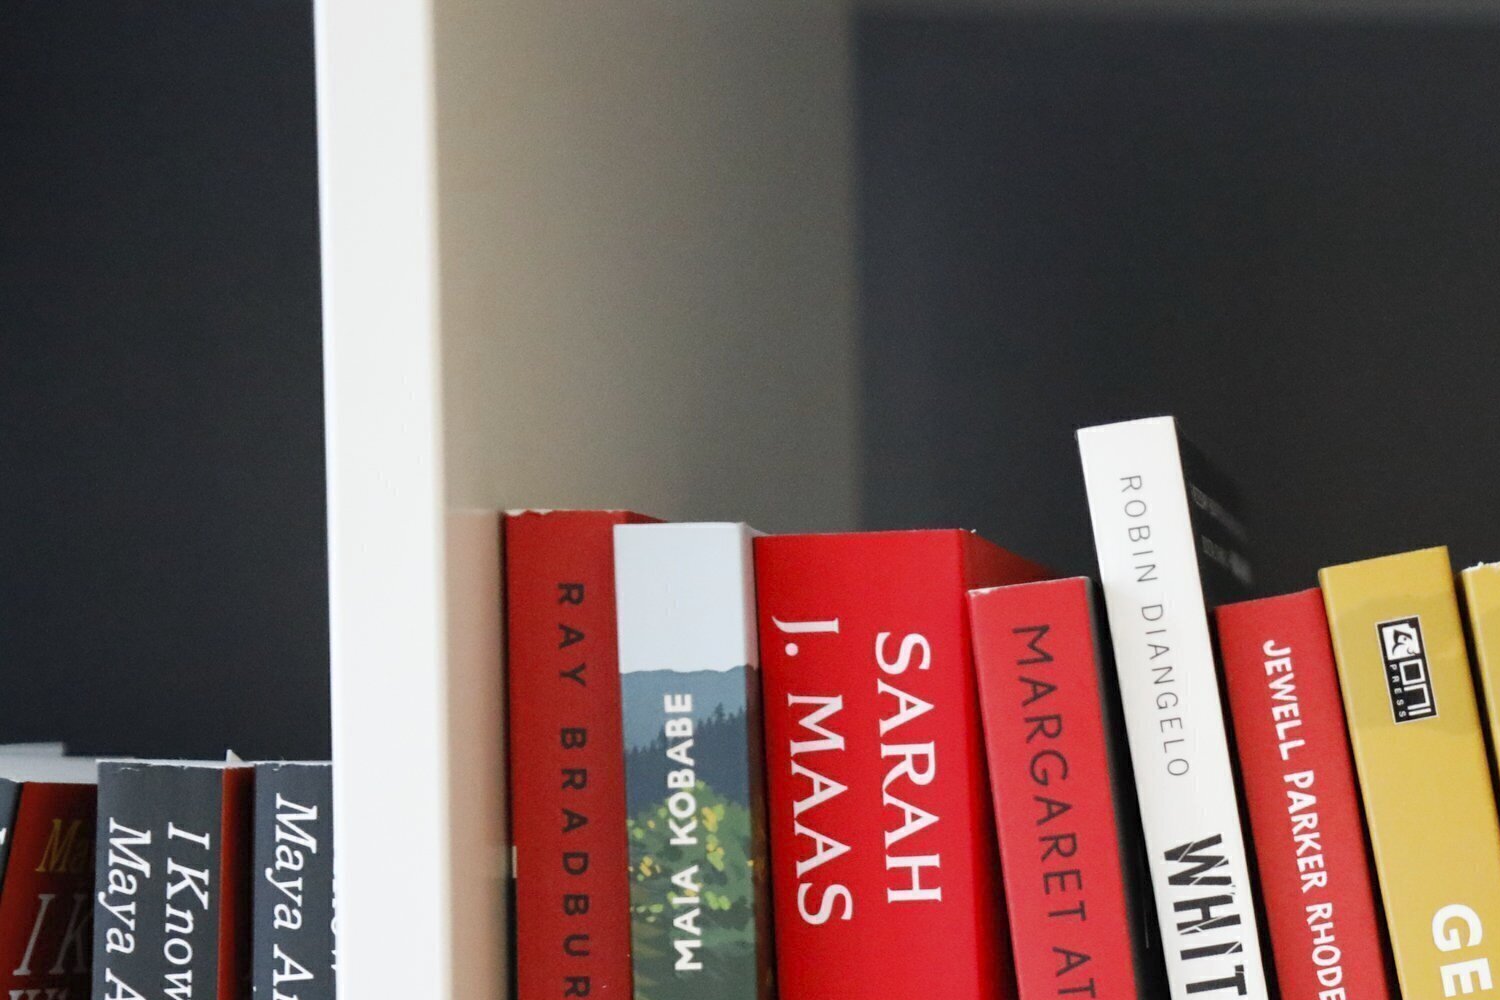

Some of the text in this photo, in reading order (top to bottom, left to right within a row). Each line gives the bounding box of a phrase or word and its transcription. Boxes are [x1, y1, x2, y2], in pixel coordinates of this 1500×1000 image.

[556, 583, 587, 687] RAY
[1119, 474, 1190, 777] ROBIN DIANGELO
[1389, 663, 1406, 718] PRESS
[875, 631, 943, 904] SARAH
[1263, 639, 1306, 761] JEWELL
[168, 821, 210, 849] I
[664, 693, 703, 972] MAIA KOBABE
[771, 615, 854, 926] J. MAAS
[1012, 624, 1088, 922] MARGARET
[1283, 769, 1328, 894] PARKER
[97, 816, 151, 954] Maya
[265, 793, 318, 930] Maya
